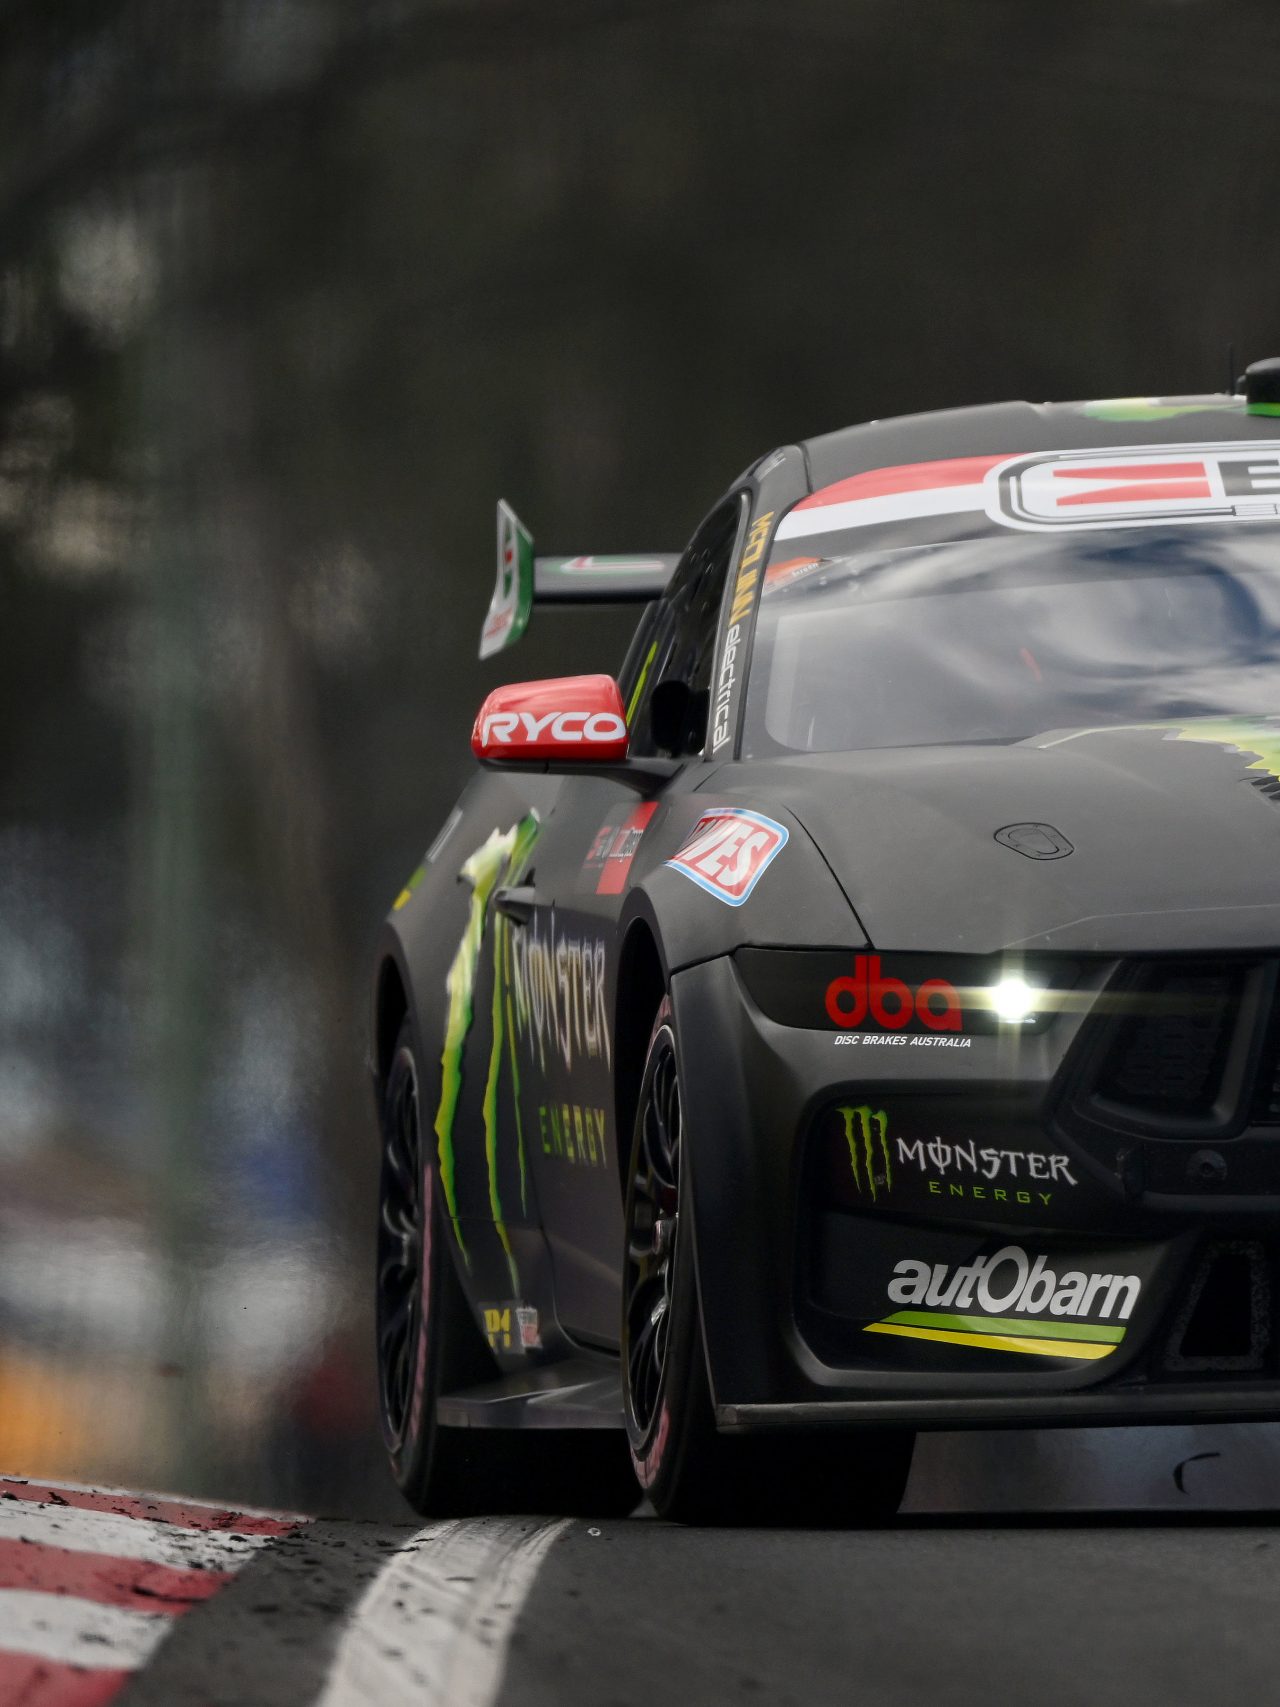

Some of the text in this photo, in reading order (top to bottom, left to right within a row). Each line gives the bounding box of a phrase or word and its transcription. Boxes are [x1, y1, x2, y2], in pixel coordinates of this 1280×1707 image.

[712, 623, 741, 754] electrical
[481, 712, 627, 748] RYCO
[825, 955, 963, 1031] dba
[834, 1035, 972, 1048] DISC BRAKES AUSTRALIA
[539, 1103, 608, 1169] ENERGY
[896, 1136, 1078, 1186] MONSTER
[928, 1181, 1052, 1206] ENERGY
